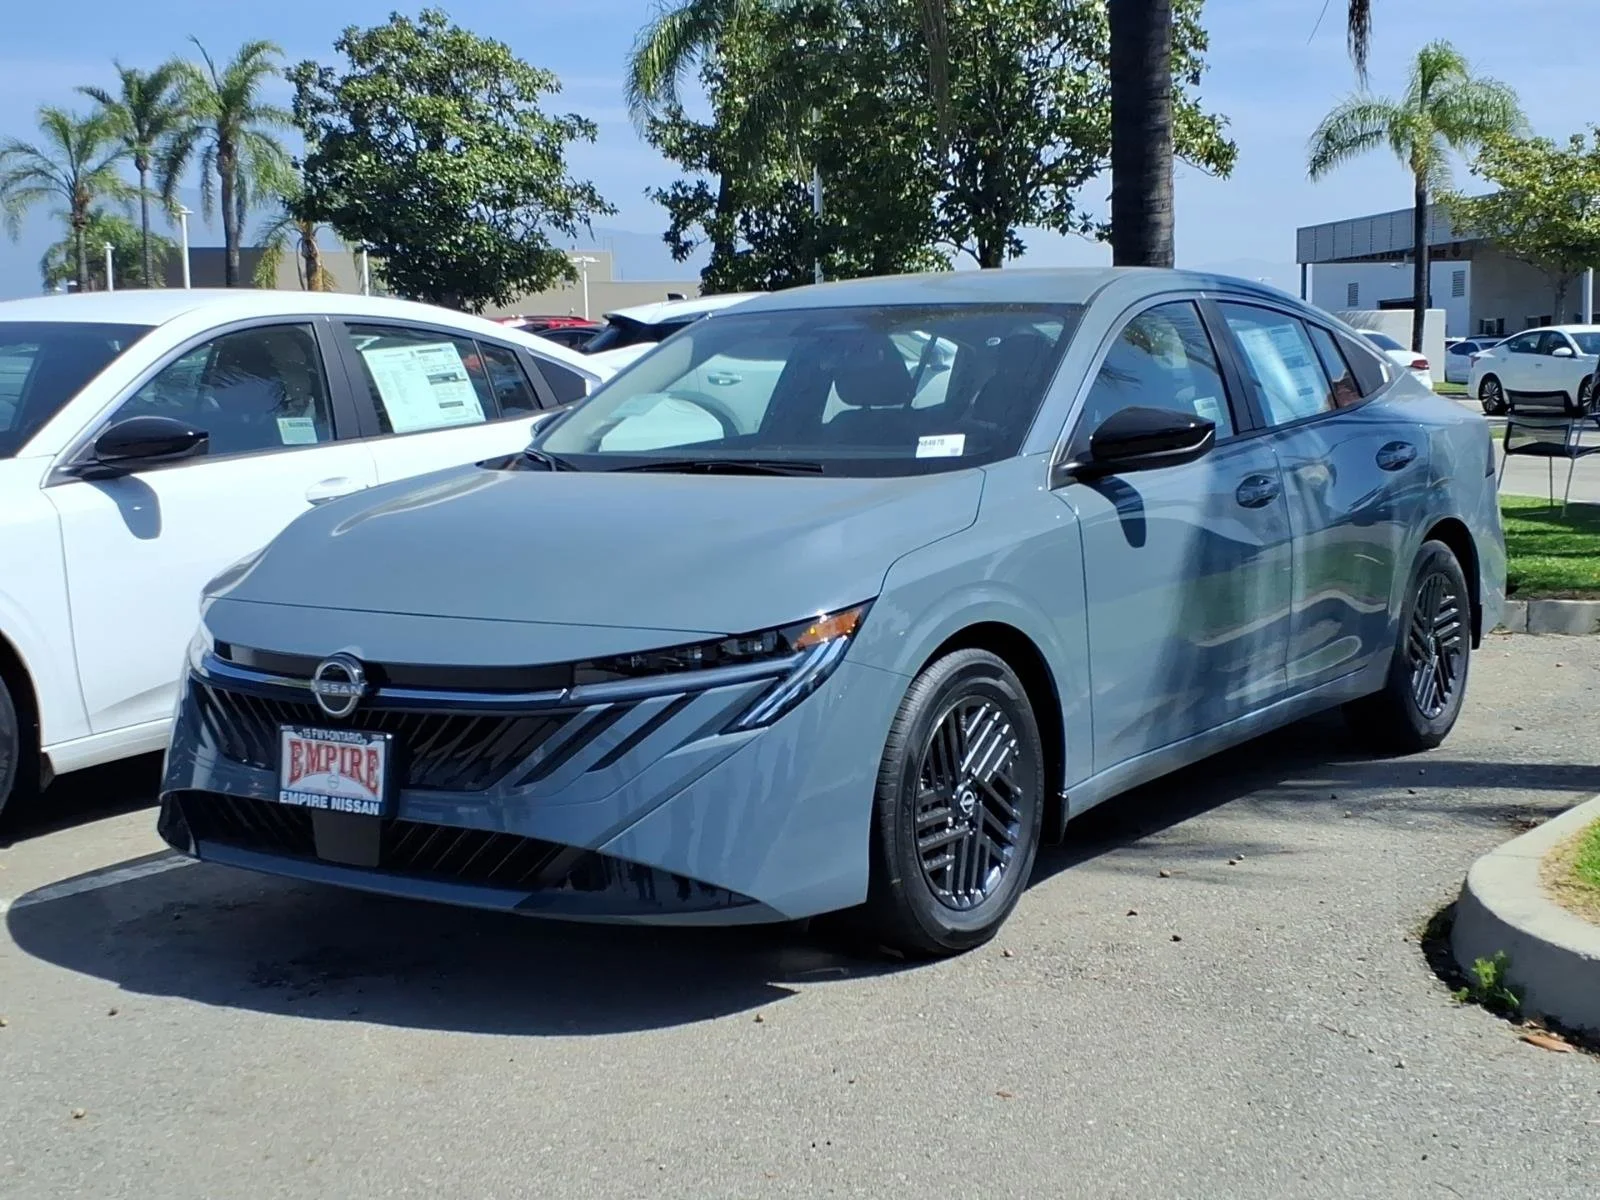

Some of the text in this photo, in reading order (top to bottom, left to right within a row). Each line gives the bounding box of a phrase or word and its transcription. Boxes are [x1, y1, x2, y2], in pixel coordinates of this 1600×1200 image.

[289, 738, 379, 796] EMPIRE
[280, 791, 328, 808] EMPIRE
[330, 797, 379, 815] NISSAN
